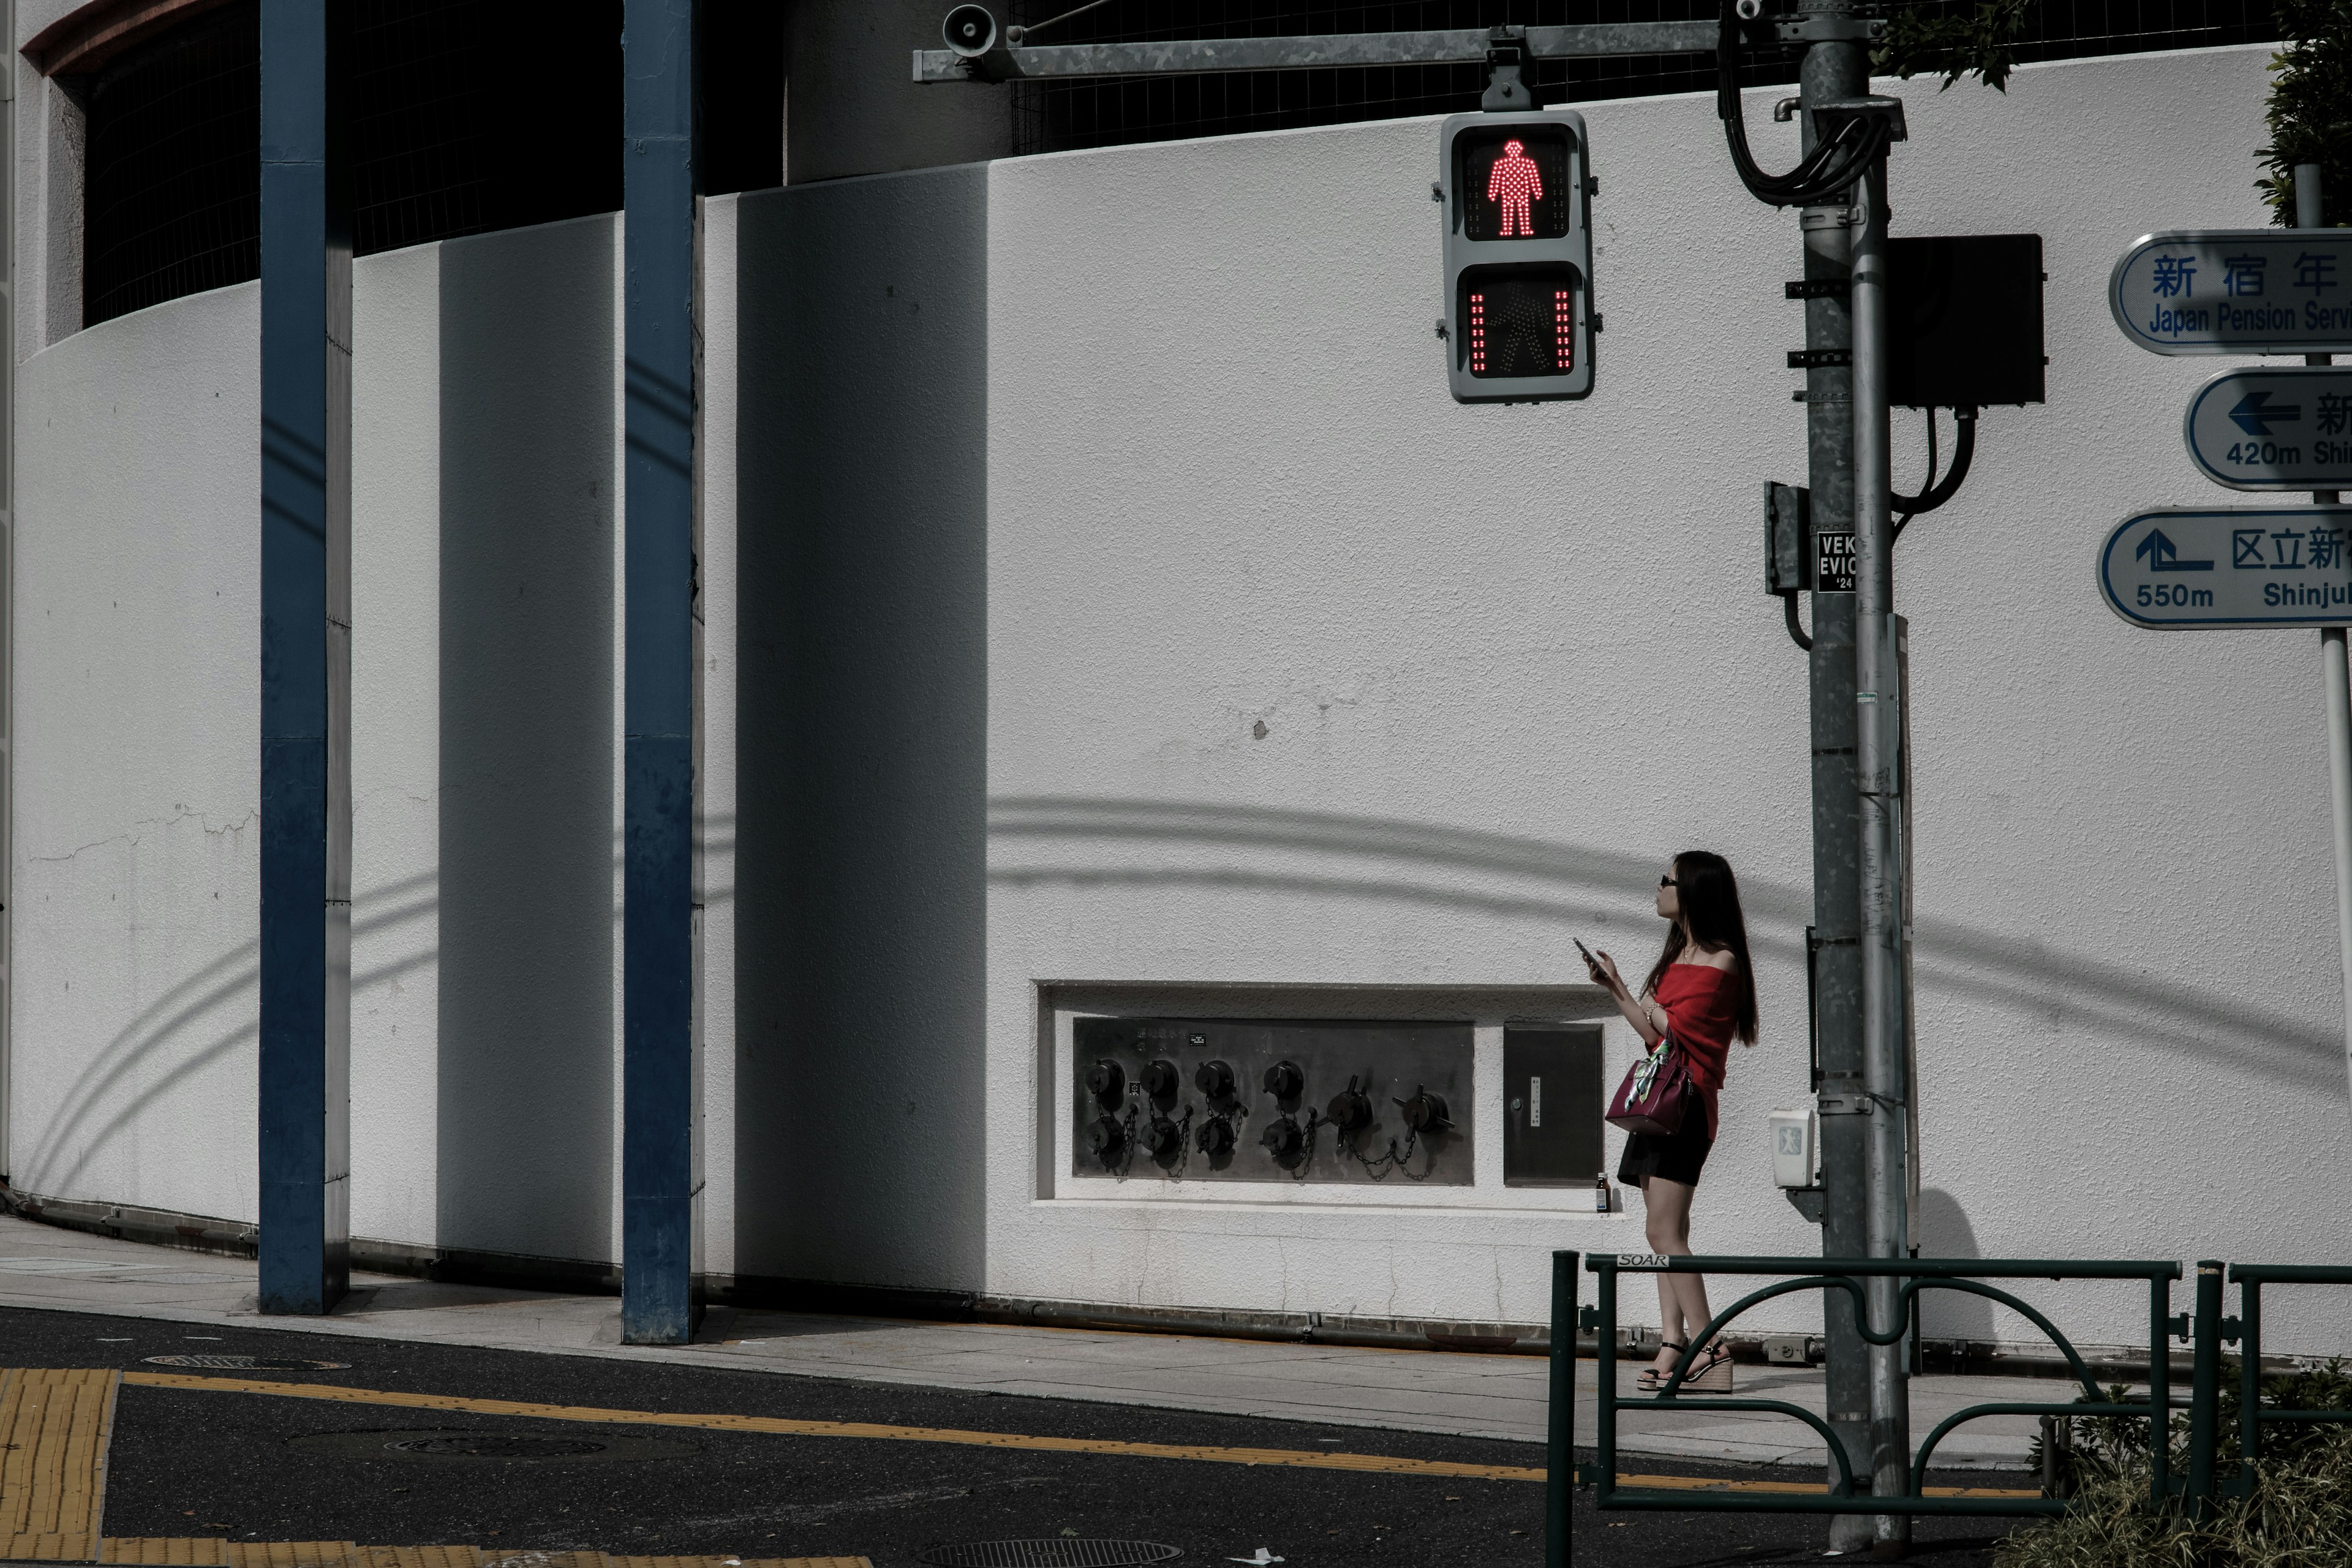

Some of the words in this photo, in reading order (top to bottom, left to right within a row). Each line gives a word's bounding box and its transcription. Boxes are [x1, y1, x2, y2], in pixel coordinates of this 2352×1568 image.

[2152, 252, 2338, 298] 新宿年
[2150, 303, 2209, 337] Japan
[2218, 301, 2295, 331] Pension
[2226, 442, 2301, 465] 420m
[1823, 536, 1856, 554] VEK
[2233, 526, 2352, 570] 区立新
[2137, 584, 2214, 608] 550m
[1618, 1254, 1668, 1267] SOAR
